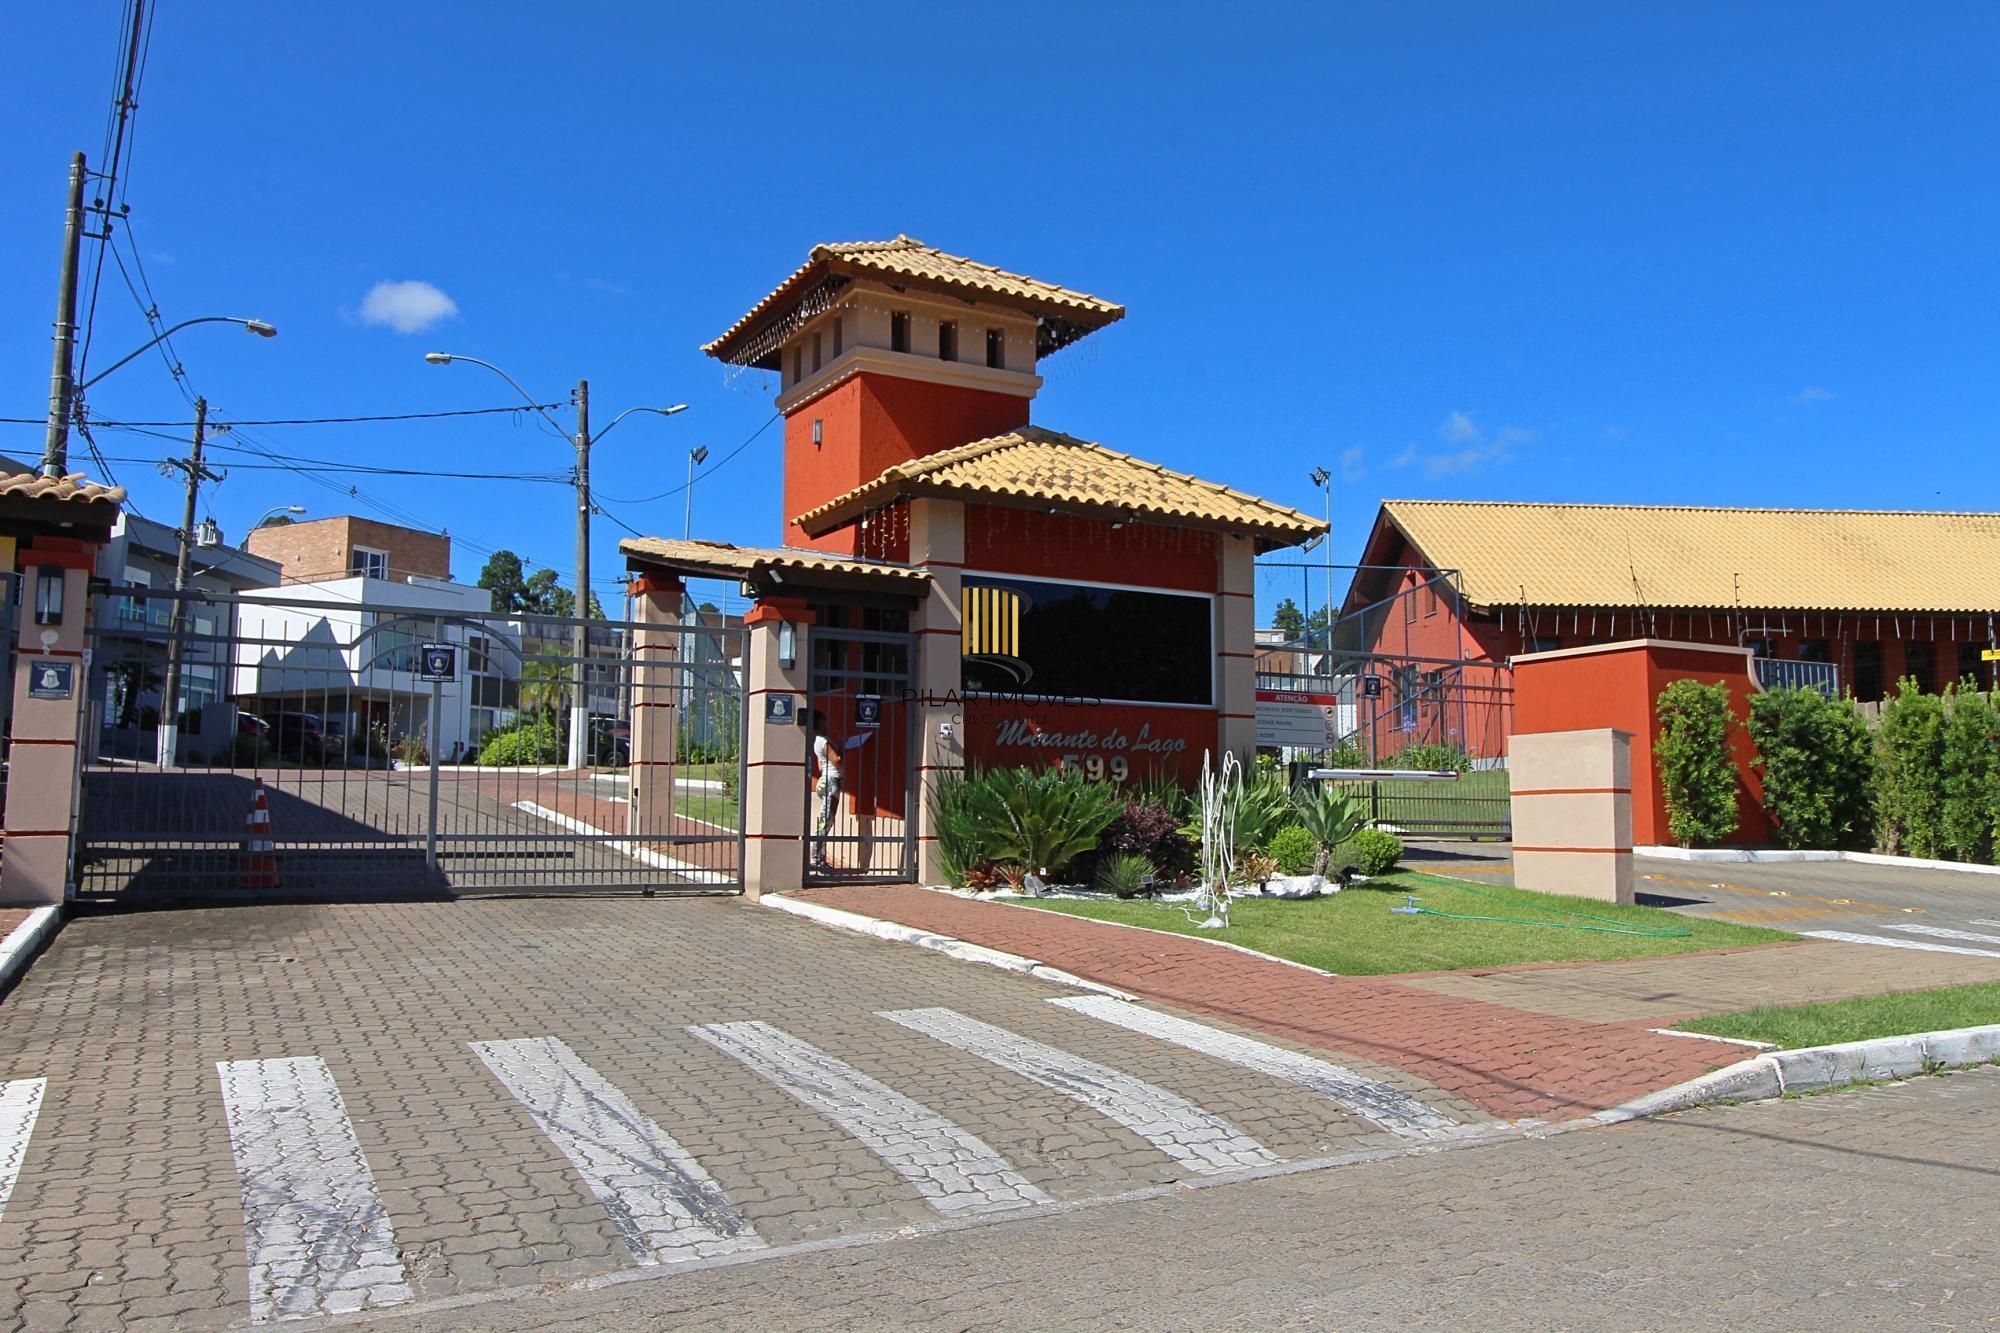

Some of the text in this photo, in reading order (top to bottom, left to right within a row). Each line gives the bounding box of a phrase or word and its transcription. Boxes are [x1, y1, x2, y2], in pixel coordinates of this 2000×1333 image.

[1275, 693, 1308, 703] ATENÇÃO
[1102, 728, 1128, 749] do
[1130, 722, 1187, 760] Lago
[1061, 754, 1129, 782] 599
